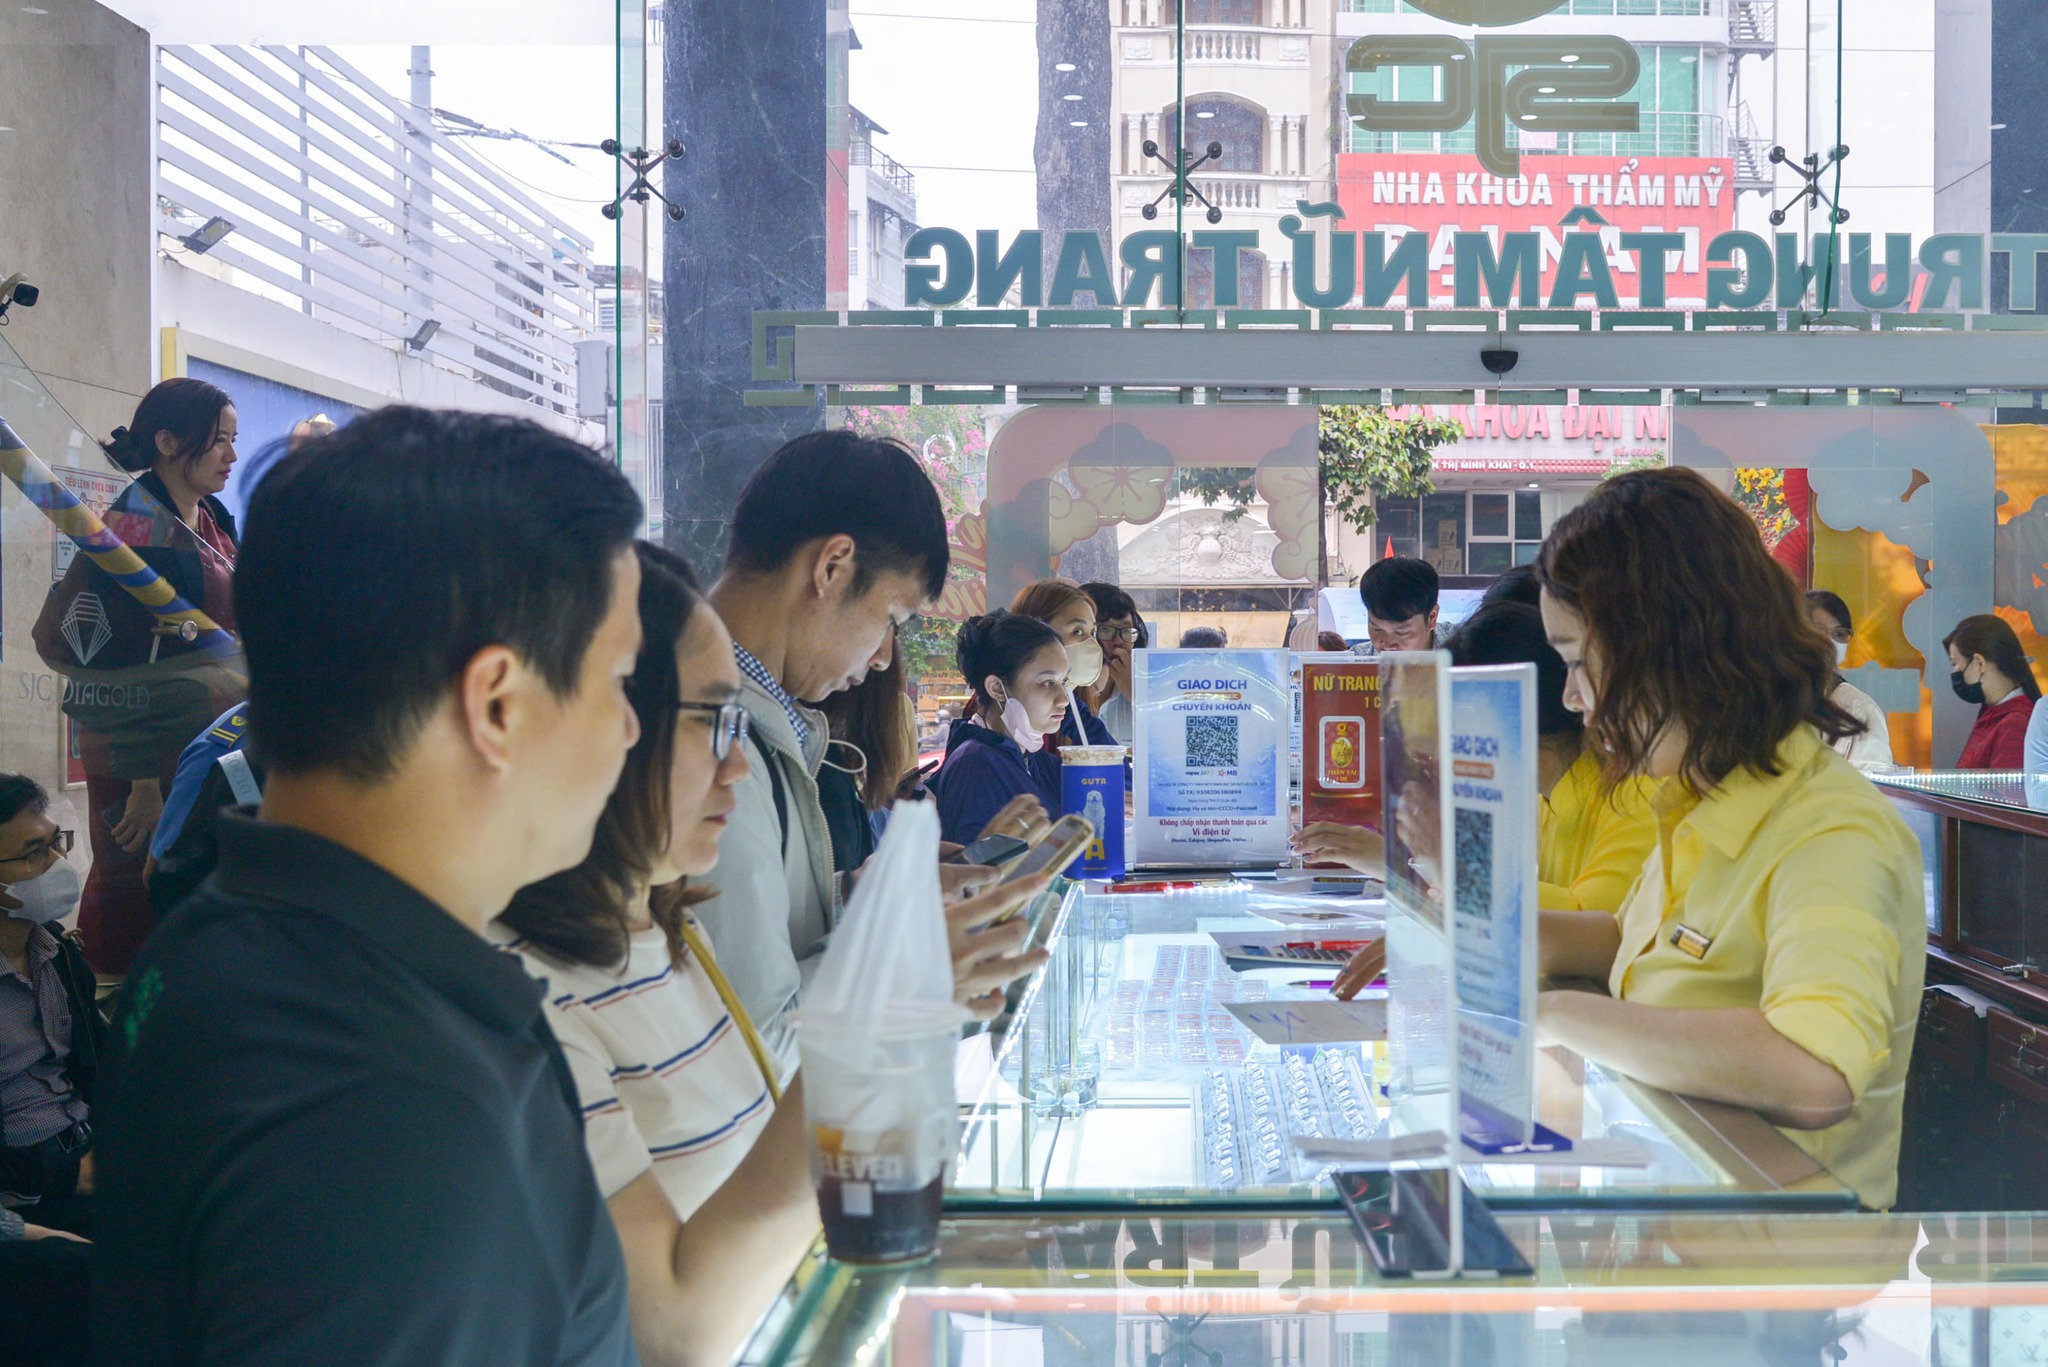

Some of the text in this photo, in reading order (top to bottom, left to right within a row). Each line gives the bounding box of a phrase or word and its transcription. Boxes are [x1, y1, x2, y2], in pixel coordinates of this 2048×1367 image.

[1373, 158, 1725, 208] NHA KHOA THẨM MỸ
[1460, 460, 1486, 469] MINH
[1488, 460, 1512, 469] KHAI
[1177, 679, 1247, 692] GIAO DỊCH
[1313, 673, 1335, 691] NỮ
[18, 671, 152, 709] SJC DIAGOLD
[1159, 819, 1179, 828] Không
[1180, 818, 1194, 827] chấp
[1195, 819, 1211, 827] nhận
[1192, 827, 1231, 837] Ví điện tử
